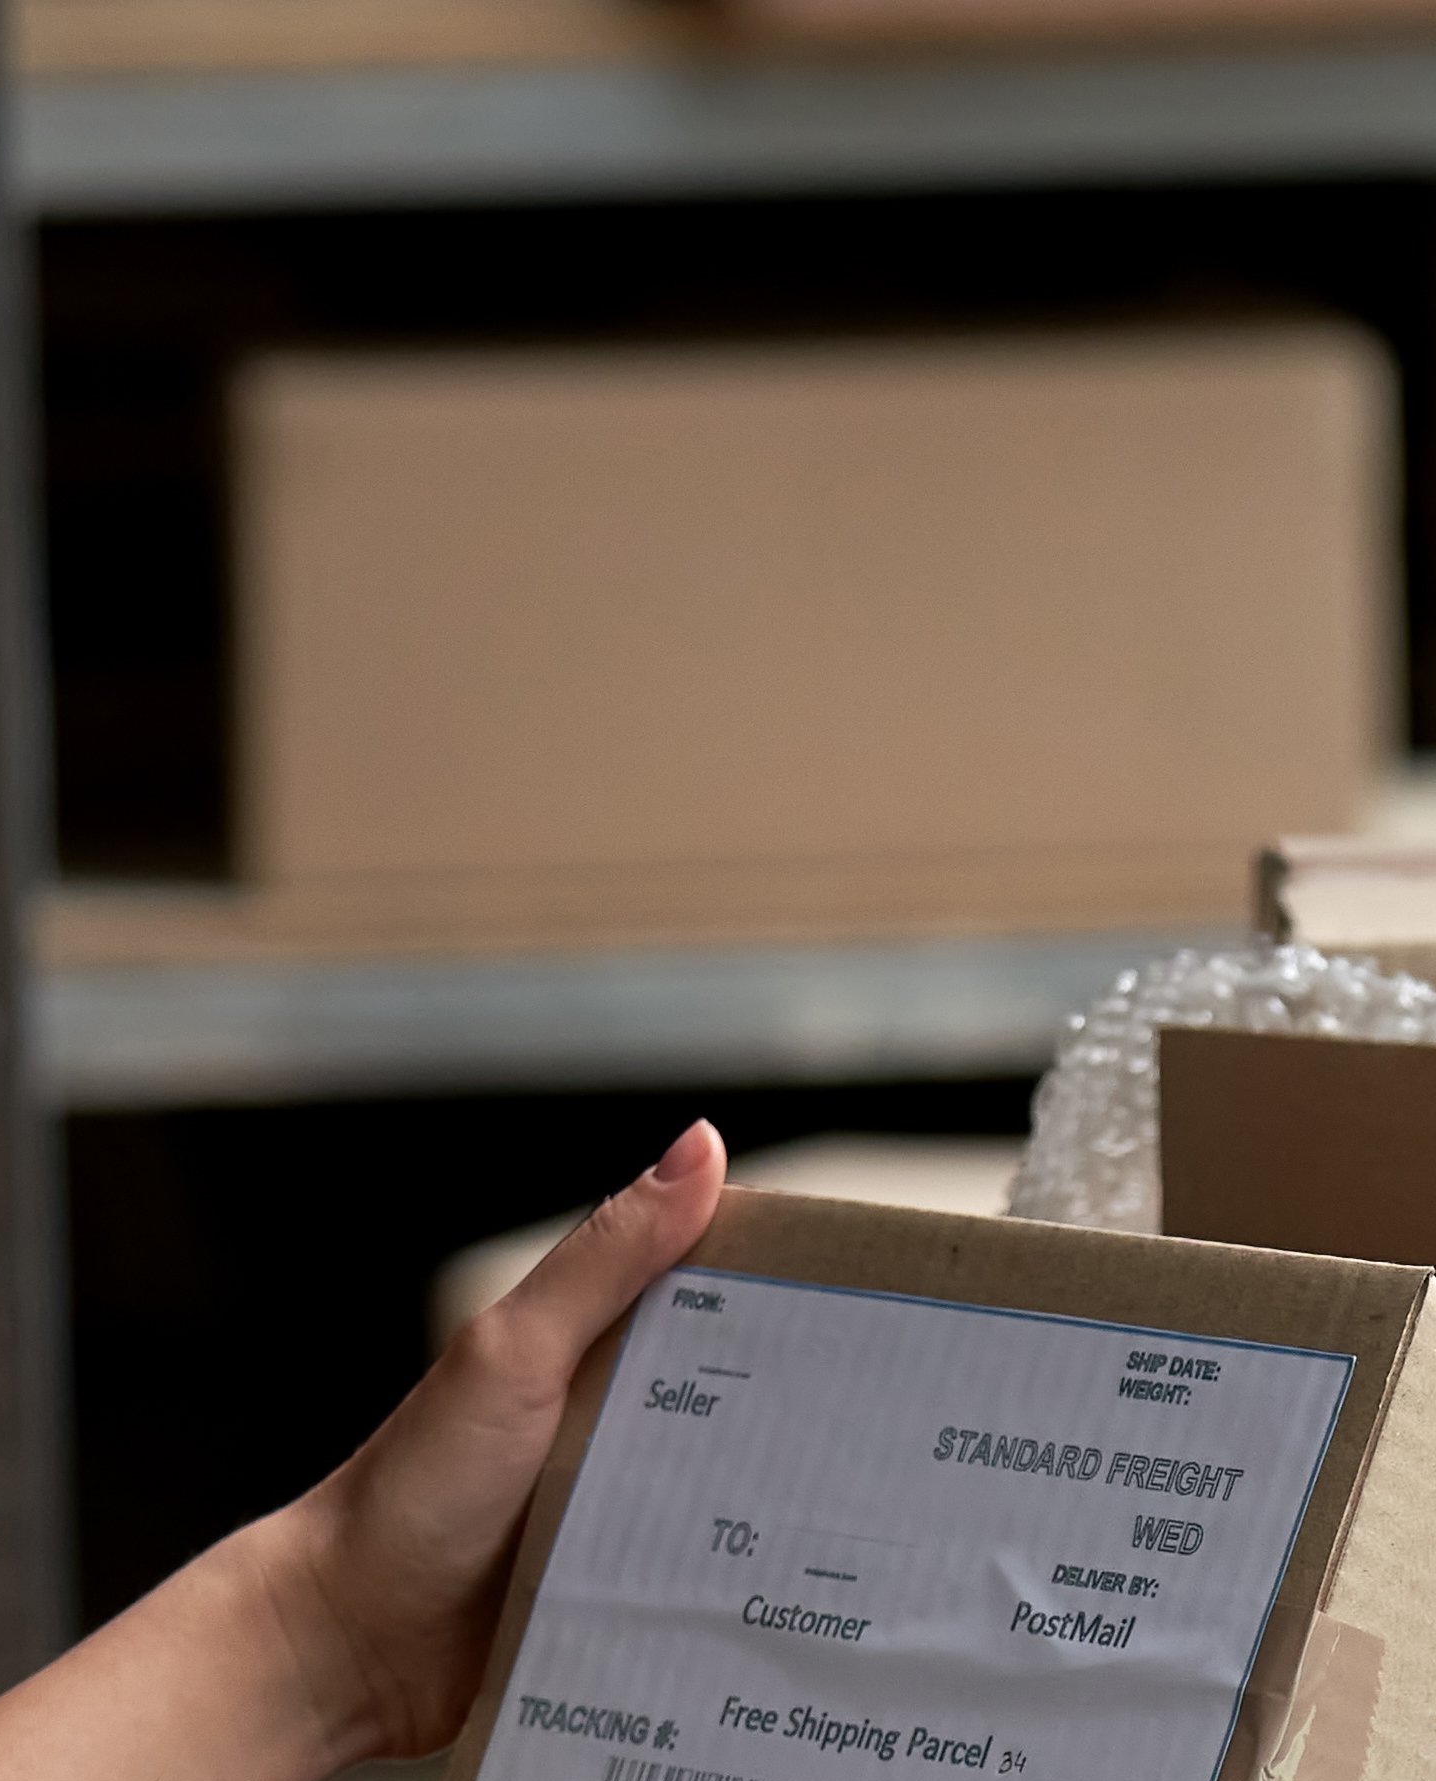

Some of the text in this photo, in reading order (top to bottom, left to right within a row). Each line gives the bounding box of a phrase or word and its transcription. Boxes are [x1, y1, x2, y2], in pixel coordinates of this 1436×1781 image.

[672, 1285, 727, 1314] FROM:
[1126, 1350, 1222, 1382] SHIP DATE:
[643, 1377, 722, 1418] Seller
[1118, 1376, 1192, 1406] WEIGHT:
[932, 1426, 1245, 1502] STANDARD FREIGHT
[711, 1517, 760, 1558] TO:
[1131, 1513, 1205, 1556] WED
[1051, 1564, 1161, 1600] DELIVER BY:
[741, 1593, 873, 1643] Customer
[1009, 1600, 1137, 1650] PostMail
[517, 1695, 650, 1746] TRACKING
[719, 1694, 995, 1770] Free Shipping Parcel
